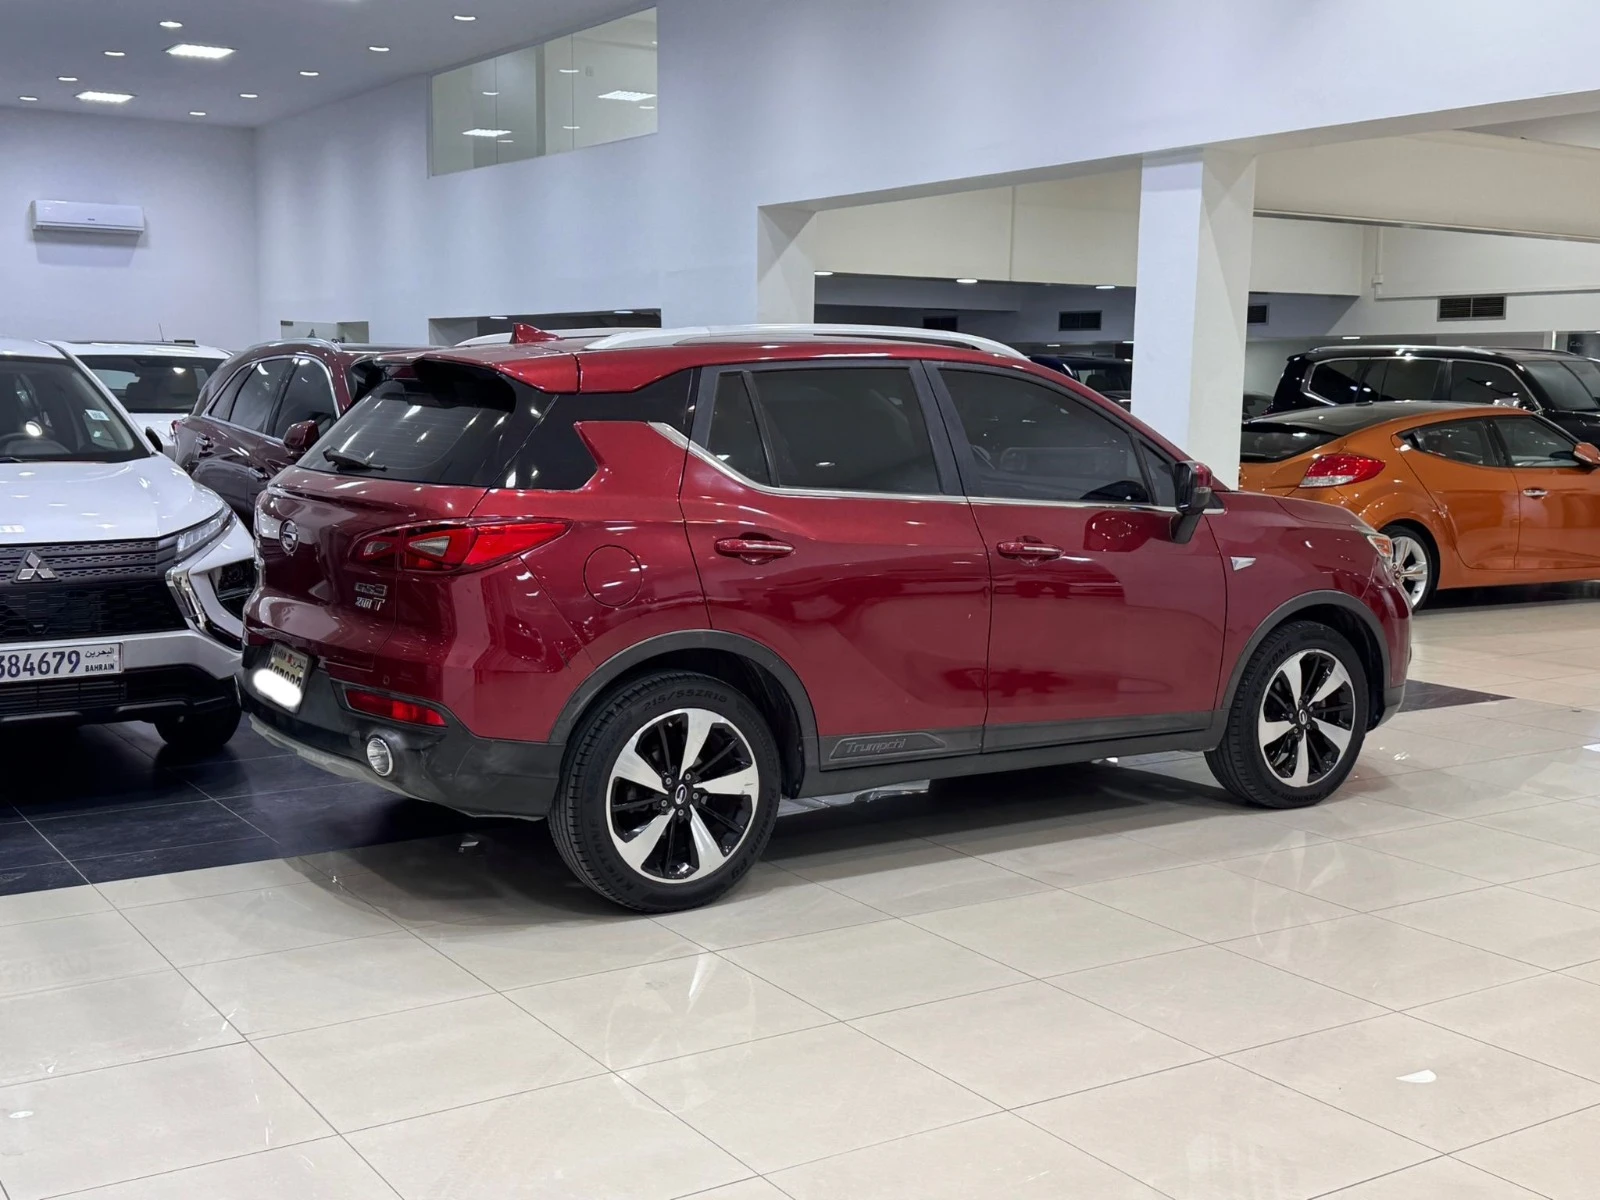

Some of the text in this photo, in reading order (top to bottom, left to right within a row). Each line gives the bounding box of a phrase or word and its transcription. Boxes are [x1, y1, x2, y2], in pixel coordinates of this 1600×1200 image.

[85, 647, 114, 658] البحرين
[85, 663, 115, 672] BAHRAIN
[845, 738, 907, 753] Trumpchi
